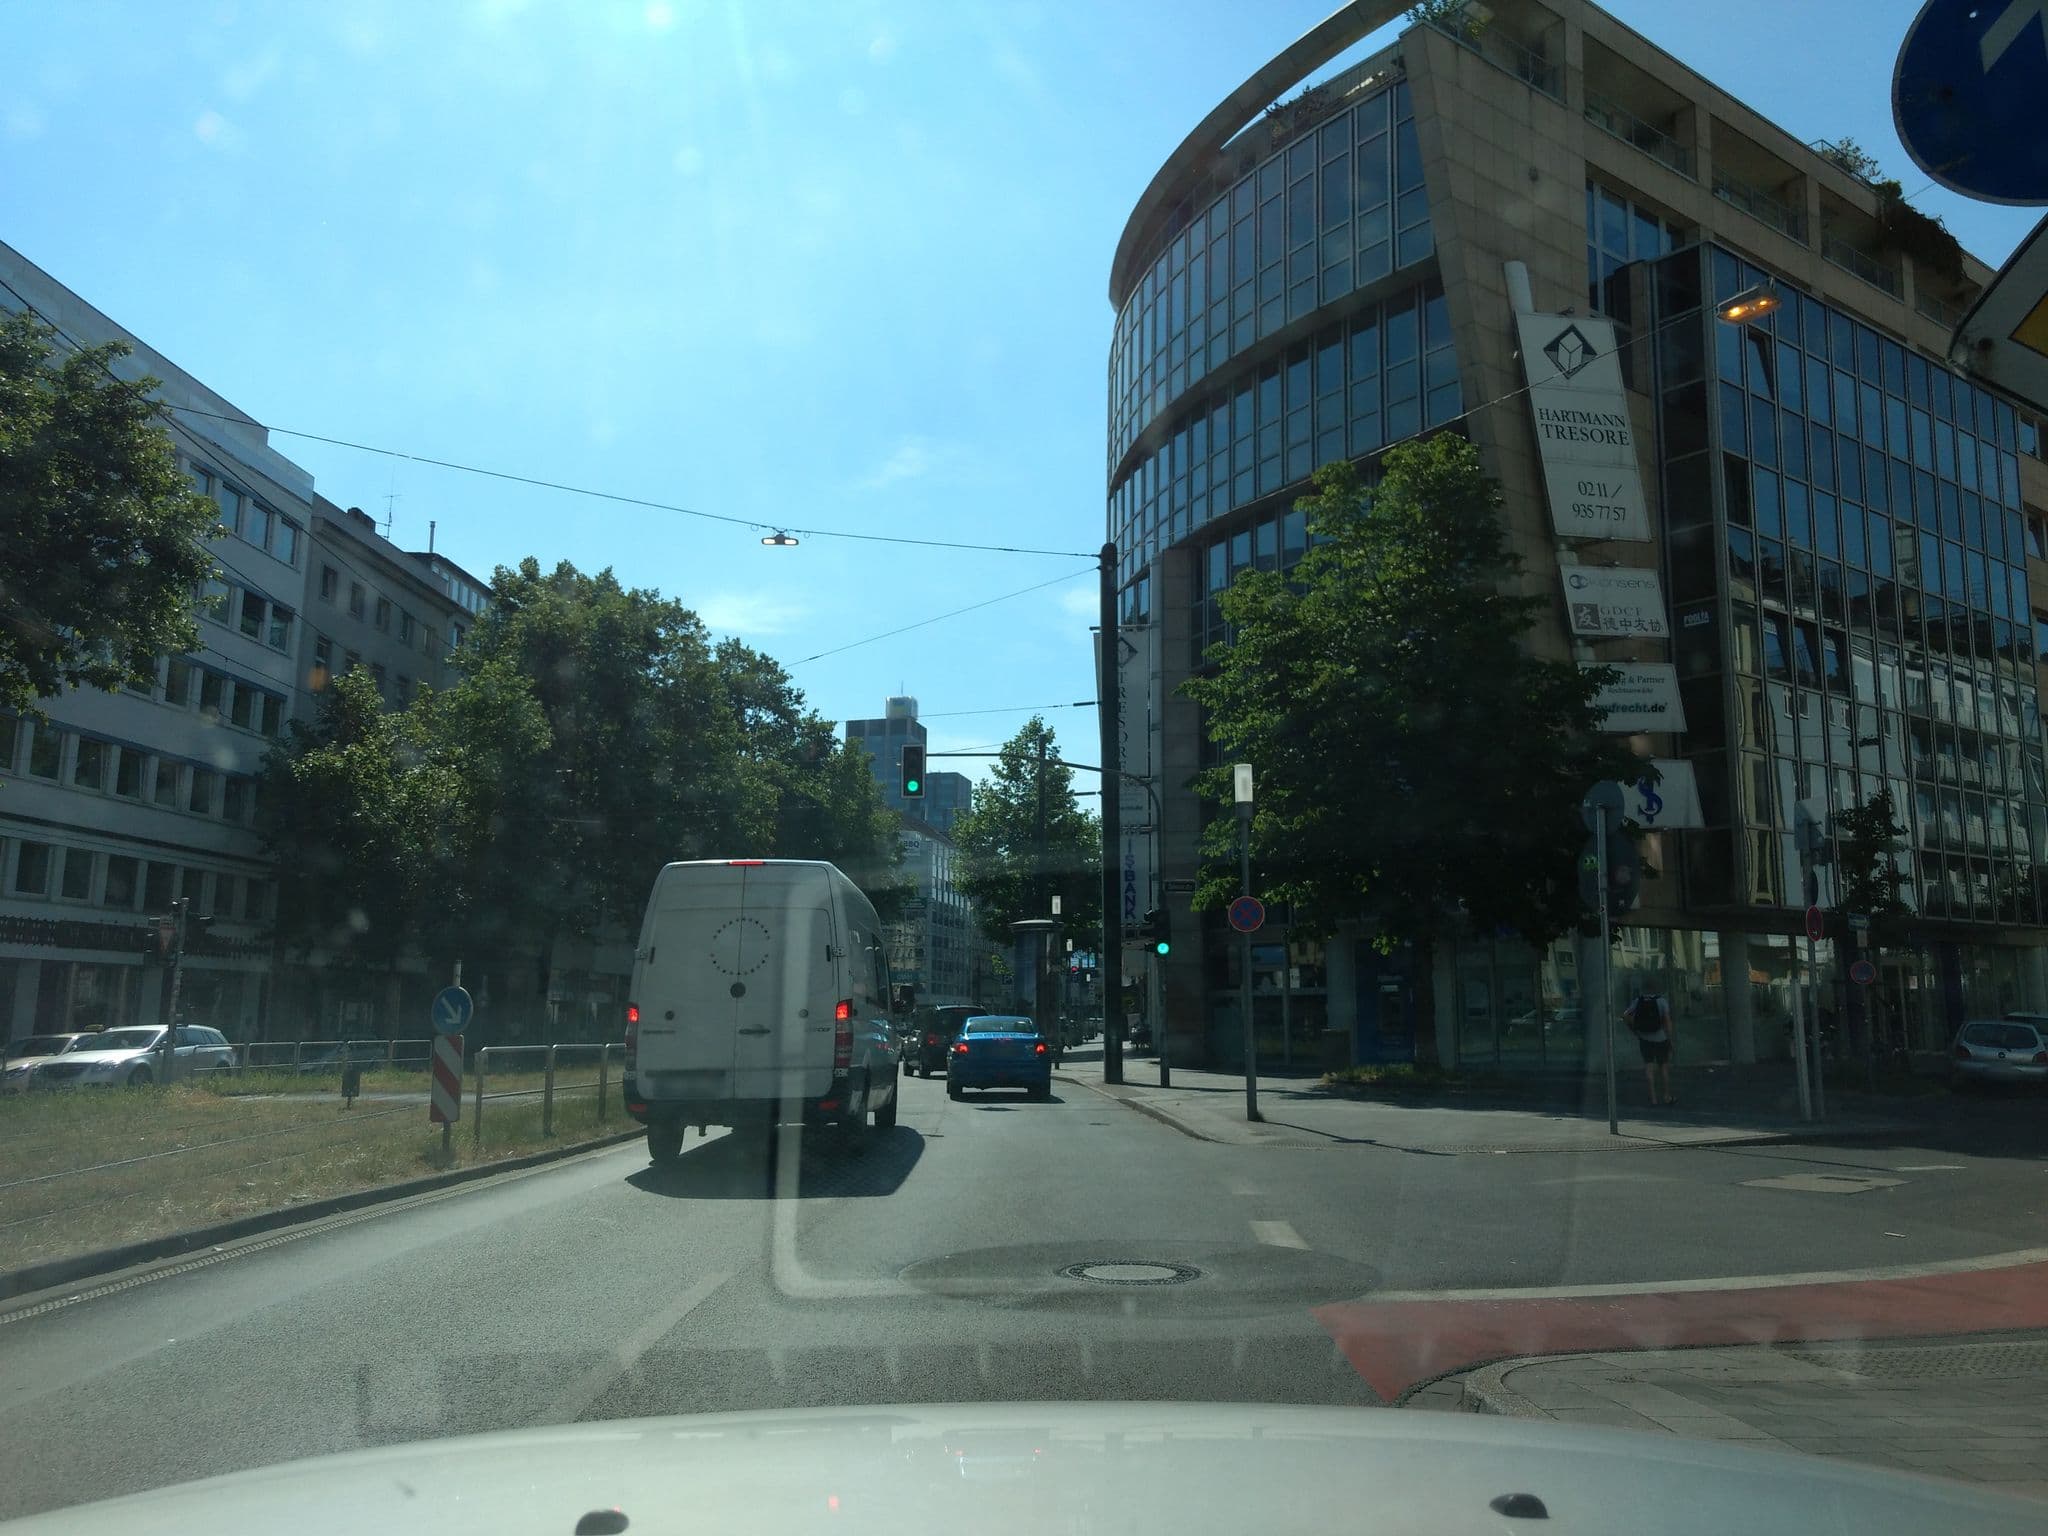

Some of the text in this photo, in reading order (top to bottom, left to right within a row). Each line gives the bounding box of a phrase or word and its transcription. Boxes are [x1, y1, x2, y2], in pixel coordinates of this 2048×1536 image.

[1539, 408, 1626, 428] HARTMANN
[1541, 423, 1631, 446] TRESORE
[1637, 674, 1665, 684] Partner
